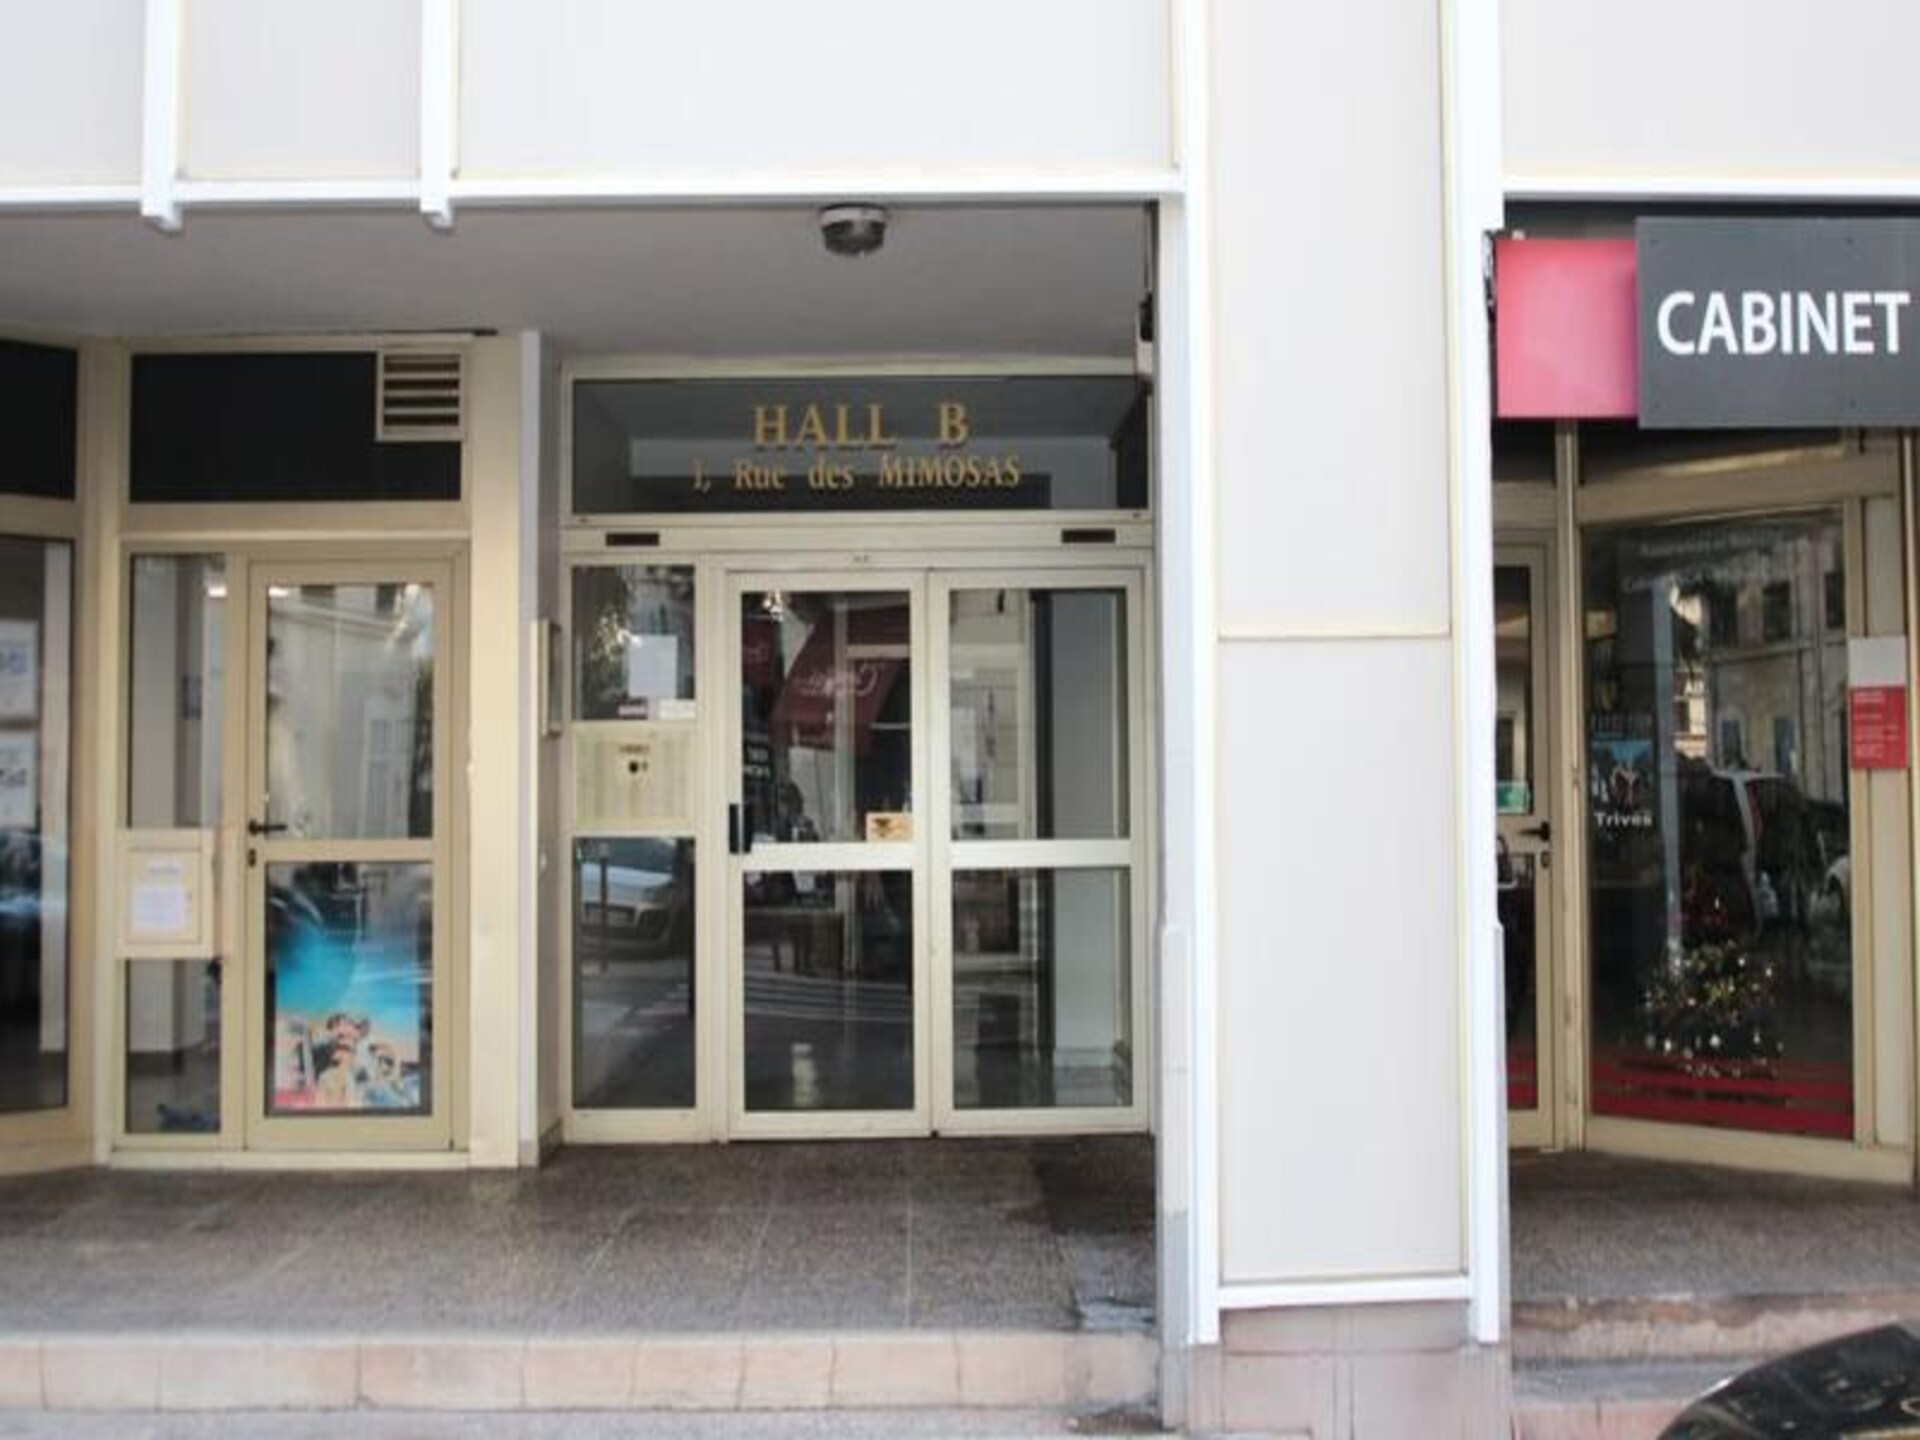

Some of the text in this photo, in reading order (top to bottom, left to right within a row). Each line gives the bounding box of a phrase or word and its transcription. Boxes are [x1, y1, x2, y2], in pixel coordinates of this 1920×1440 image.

[1657, 290, 1911, 355] CABINET
[755, 402, 969, 446] HALL B
[733, 458, 787, 490] Rue
[808, 455, 855, 490] des
[878, 452, 1021, 489] MIMOSAS
